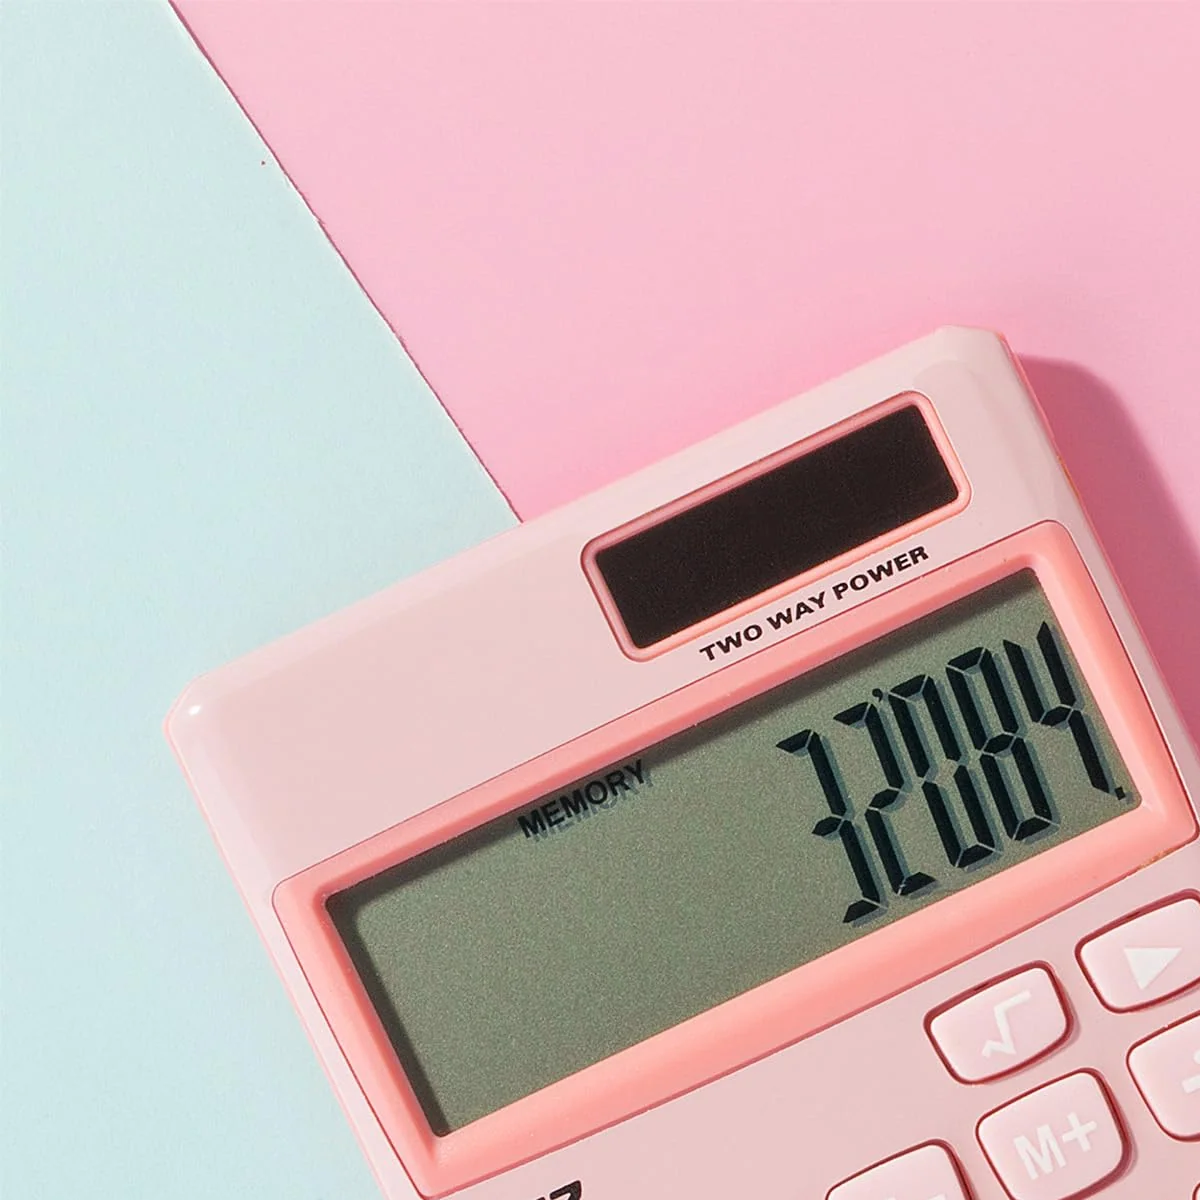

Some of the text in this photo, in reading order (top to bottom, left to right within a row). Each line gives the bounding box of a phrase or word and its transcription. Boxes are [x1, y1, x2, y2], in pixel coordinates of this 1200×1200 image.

[699, 545, 930, 662] TWO WAY POWER
[516, 759, 647, 840] MEMORY
[1013, 1111, 1098, 1181] M+
